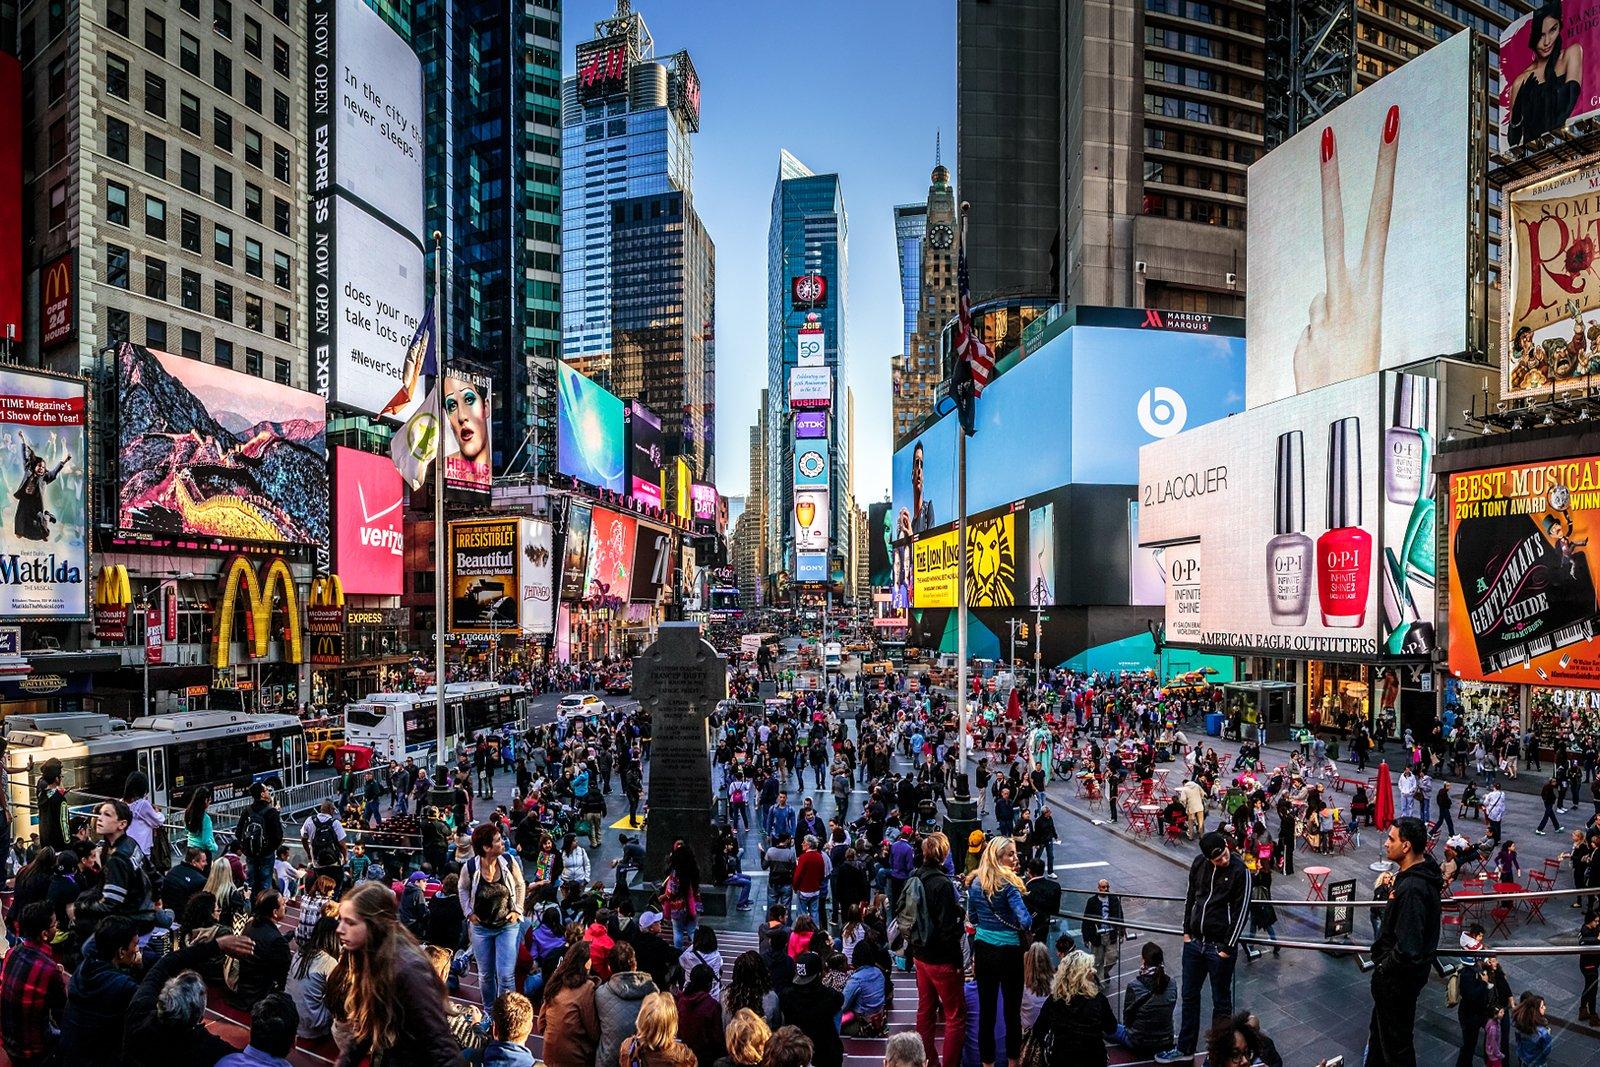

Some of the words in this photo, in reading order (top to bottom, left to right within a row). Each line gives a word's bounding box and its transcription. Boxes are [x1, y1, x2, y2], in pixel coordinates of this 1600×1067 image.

[314, 12, 329, 59] NOW
[314, 63, 329, 115] OPEN
[344, 66, 358, 90] In
[363, 82, 383, 109] the
[385, 103, 408, 132] city
[343, 94, 376, 126] never
[1531, 174, 1577, 196] BROADWAY
[315, 232, 330, 280] NOW
[46, 298, 68, 316] OPEN
[315, 283, 330, 336] OPEN
[344, 281, 372, 307] does
[376, 299, 400, 320] your
[49, 309, 66, 330] 24
[802, 322, 821, 330] 2015
[1167, 312, 1213, 323] MARRIOTT
[1167, 320, 1209, 331] MARQUIS
[44, 323, 71, 343] HOURS
[345, 307, 371, 331] take
[376, 319, 398, 343] lots
[400, 334, 412, 348] of
[472, 374, 491, 389] CRISS
[2, 398, 24, 409] TIME
[26, 399, 72, 411] Magazine's
[791, 399, 830, 407] TOSHIBA
[7, 410, 31, 421] Show
[32, 411, 42, 421] of
[43, 412, 57, 422] the
[58, 413, 79, 423] Year!
[1157, 465, 1228, 504] LACQUER
[1455, 471, 1507, 503] BEST
[694, 499, 715, 515] DATA
[1455, 501, 1480, 520] 2014
[1482, 500, 1508, 518] TONY
[1510, 496, 1546, 515] AWARD
[456, 531, 513, 548] IRRESISTIBLE!
[456, 550, 513, 568] Beautiful
[916, 551, 926, 569] THE
[927, 544, 941, 573] LION
[482, 567, 494, 576] King
[495, 567, 513, 575] Musical
[1278, 575, 1300, 585] INFINITE
[1330, 573, 1357, 582] INFINITE
[1278, 585, 1296, 594] SHINE
[1330, 583, 1351, 592] SHINE
[1350, 582, 1356, 592] 2
[1471, 532, 1545, 634] GENTLEMAN'S
[1476, 576, 1489, 594] A
[308, 610, 342, 618] McDonald's
[1178, 602, 1200, 614] SHINE
[1503, 592, 1549, 625] GUIDE
[347, 612, 383, 624] EXPRESS
[1501, 631, 1516, 641] LOVE
[1519, 618, 1544, 638] MURDER
[1200, 632, 1252, 648] AMERICAN
[1256, 634, 1292, 650] EAGLE
[1294, 635, 1377, 654] OUTFITTERS
